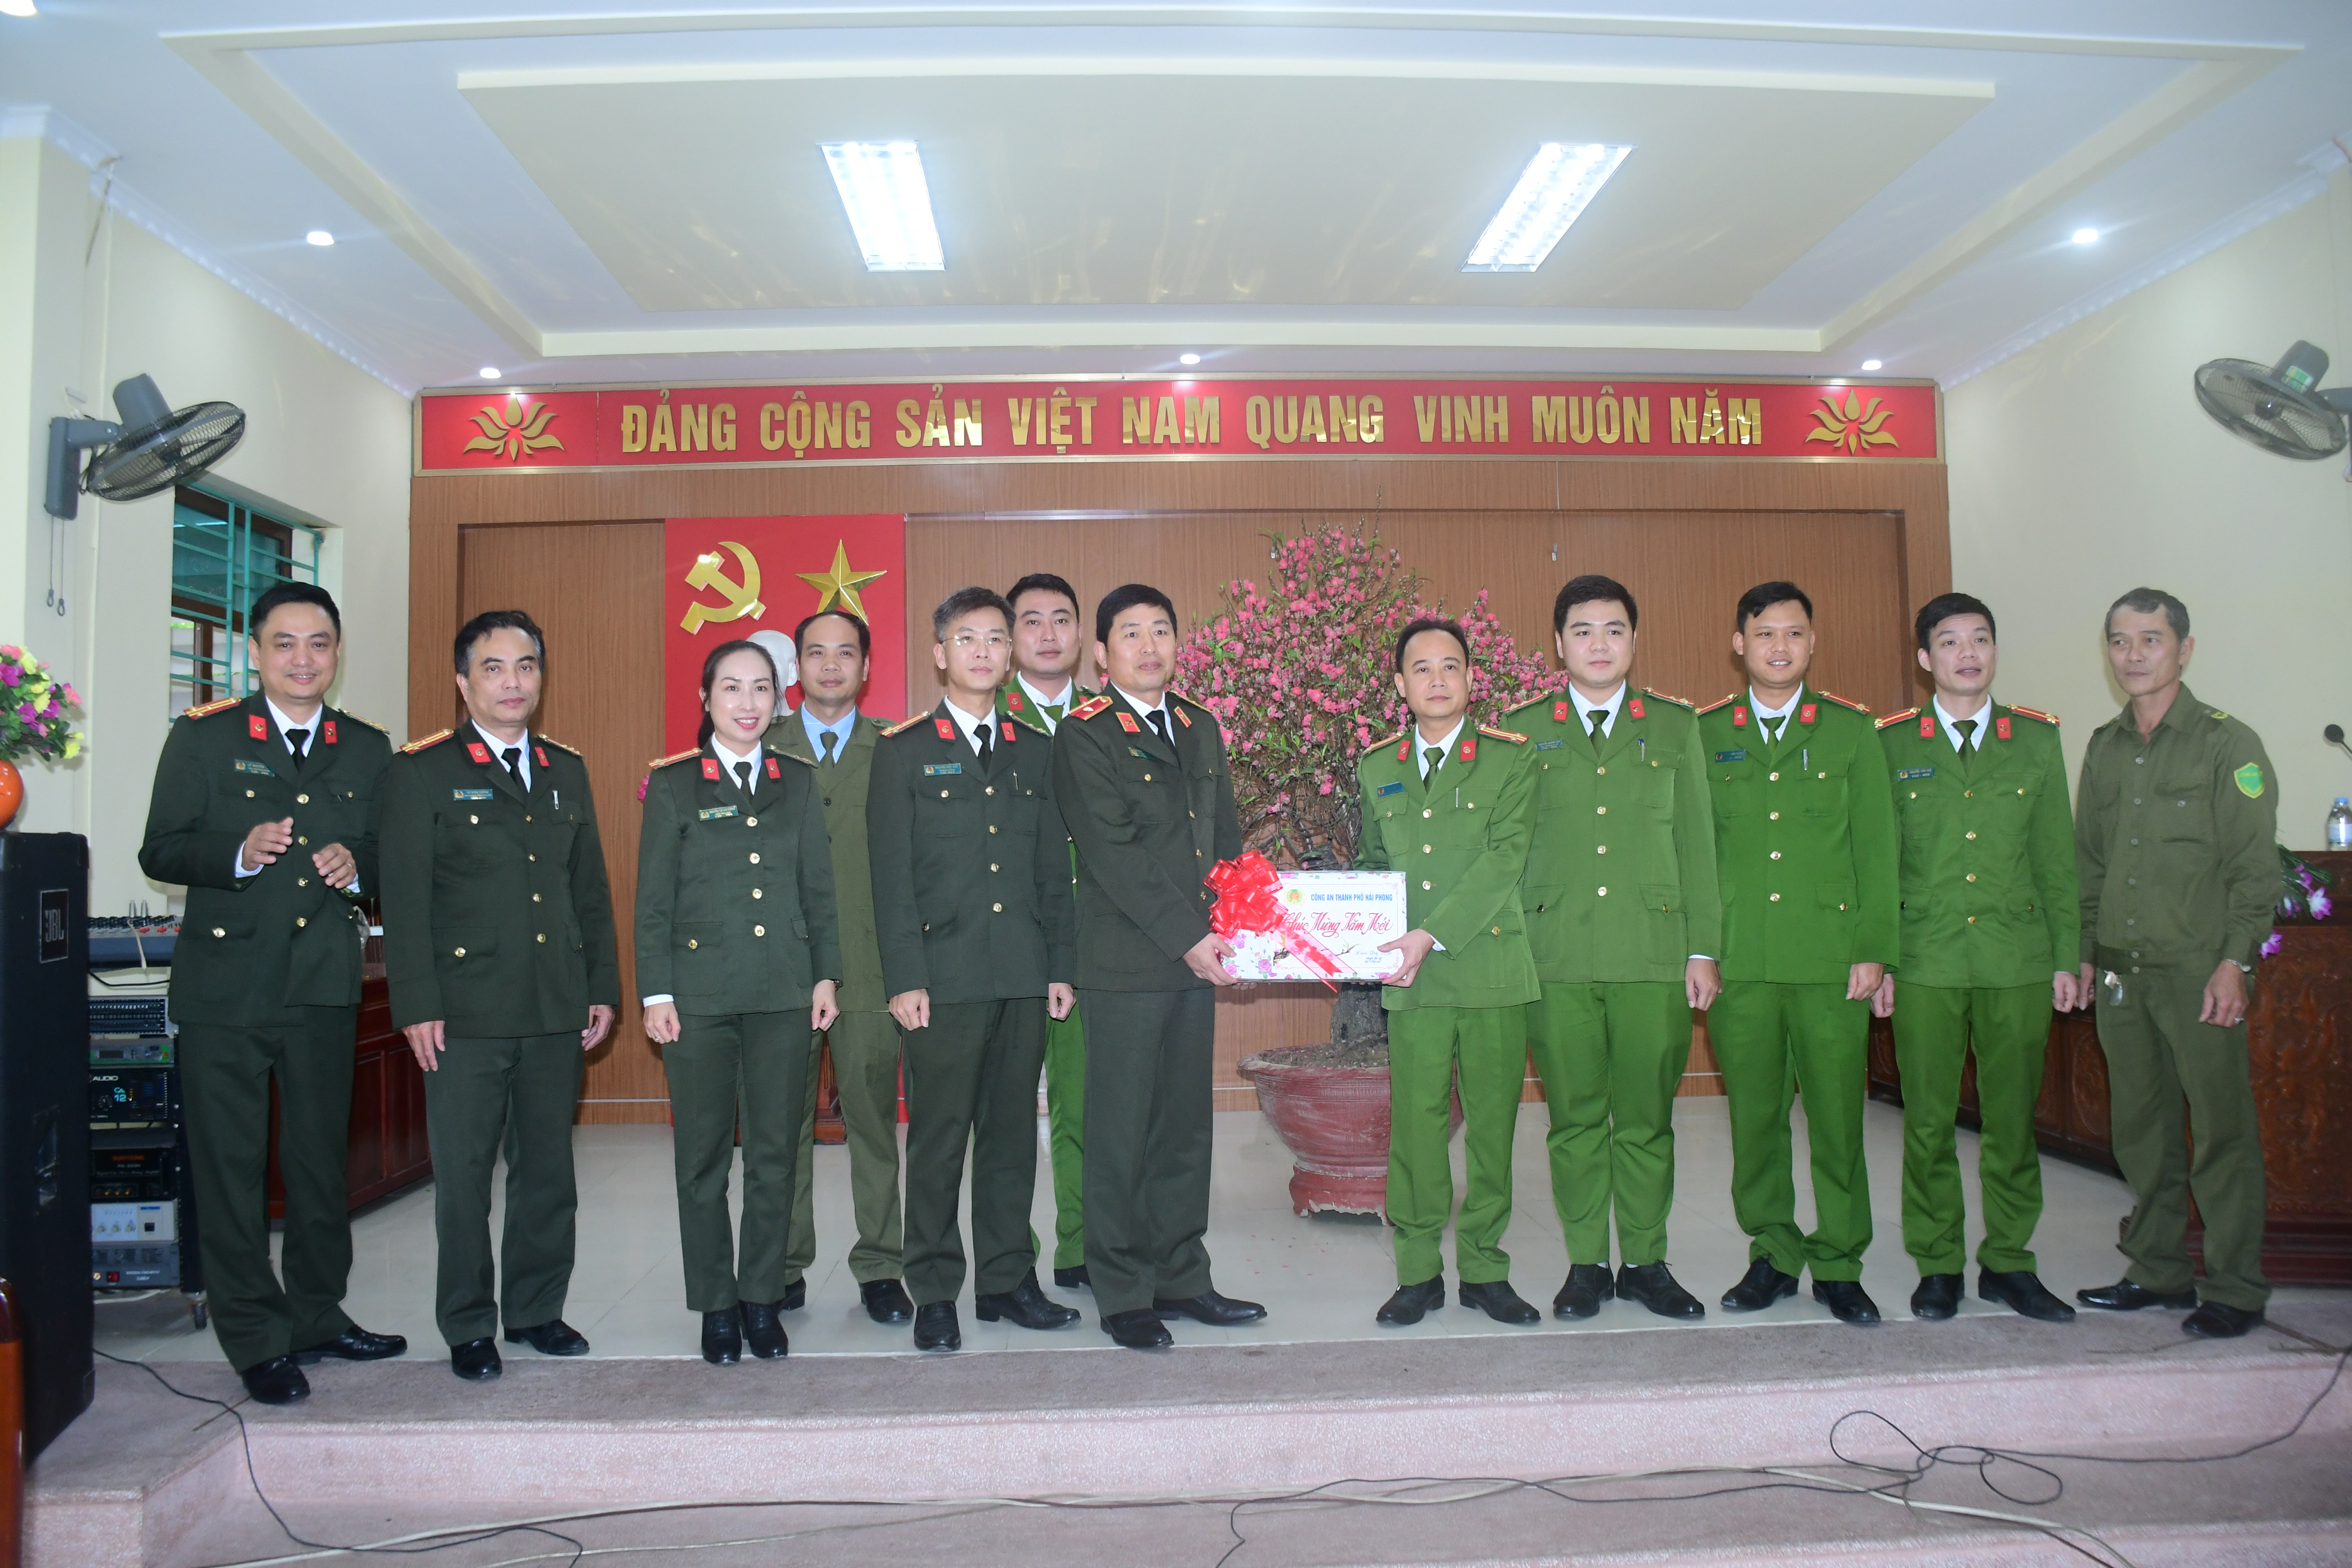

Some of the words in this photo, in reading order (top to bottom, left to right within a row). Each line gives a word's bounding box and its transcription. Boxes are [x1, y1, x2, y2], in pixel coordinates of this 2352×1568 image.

[621, 389, 736, 452] ĐẢNG
[760, 390, 870, 458] CỘNG
[896, 384, 983, 447] SẢN
[1007, 386, 1098, 454] VIỆT
[1122, 395, 1220, 444] NAM
[1245, 395, 1384, 449] QUANG
[1413, 395, 1509, 443] VINH
[1531, 385, 1650, 444] MUÔN
[1670, 388, 1762, 445] NĂM
[1311, 893, 1325, 901] CÔNG
[1335, 892, 1352, 901] THÀNH
[1353, 892, 1364, 901] PHỐ
[1375, 892, 1393, 901] PHÒNG
[44, 908, 65, 943] JBL
[1304, 912, 1341, 938] Mừng
[1341, 912, 1365, 931] Năm
[1361, 912, 1393, 934] Mới
[114, 1094, 127, 1102] 12
